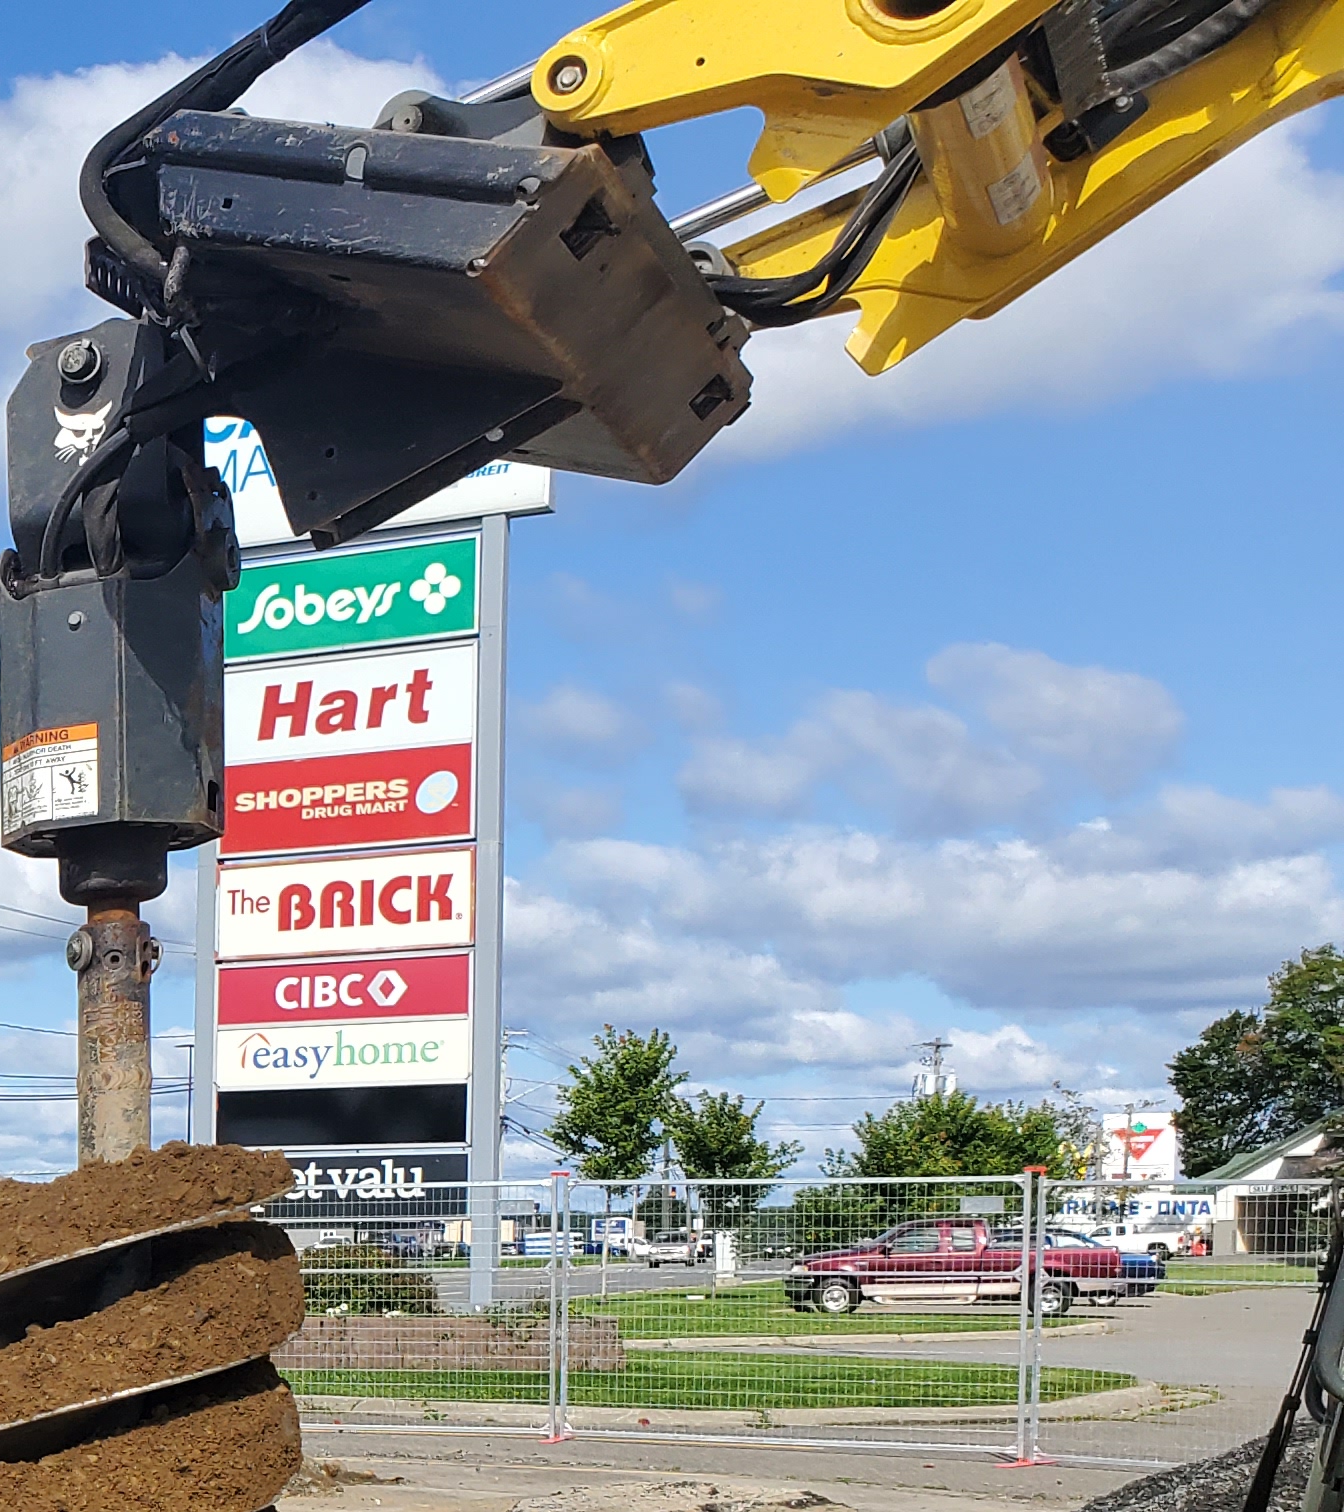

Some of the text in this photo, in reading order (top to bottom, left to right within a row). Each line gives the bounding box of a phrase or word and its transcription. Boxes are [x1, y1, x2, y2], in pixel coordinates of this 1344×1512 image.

[465, 462, 512, 478] REIT
[237, 581, 401, 634] Sobeys
[257, 668, 433, 741] Hart
[19, 729, 69, 750] WARNING
[234, 778, 410, 813] SHOPPERS
[301, 799, 408, 820] DRUG MART
[227, 873, 454, 932] The BRICK
[274, 973, 365, 1010] CIBC
[252, 1030, 440, 1079] easyhome
[327, 1158, 426, 1200] valu
